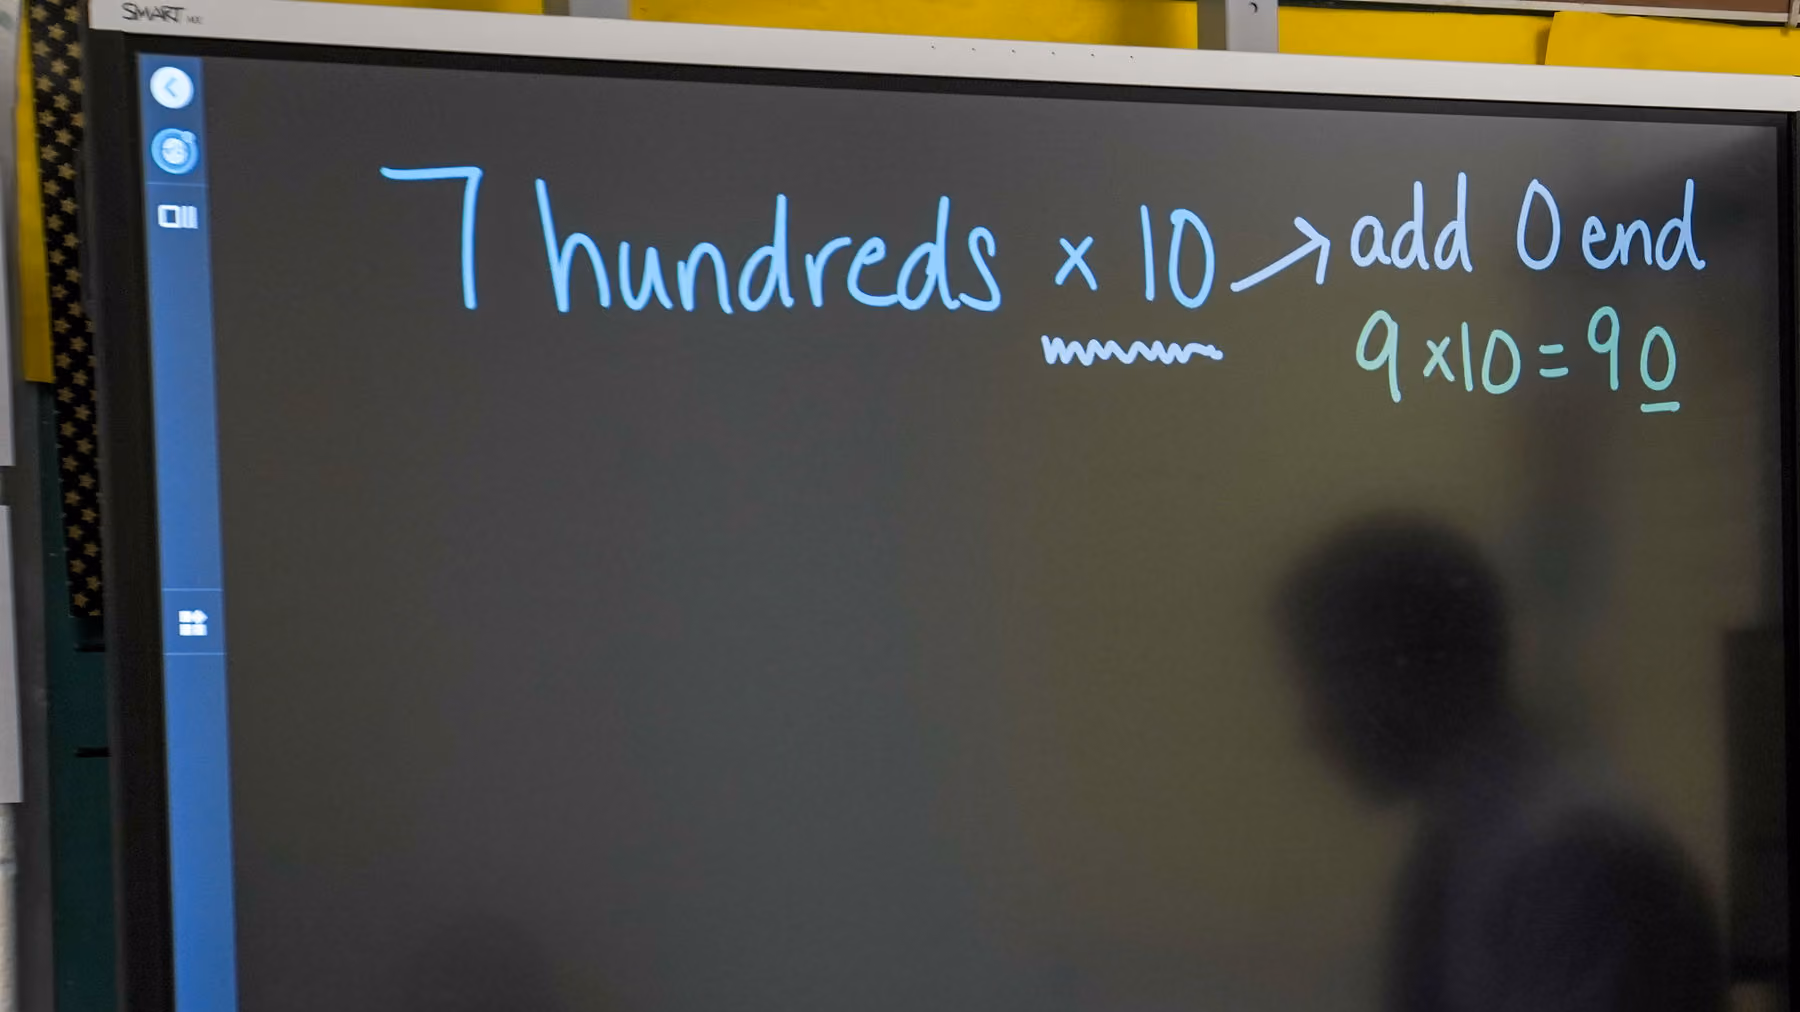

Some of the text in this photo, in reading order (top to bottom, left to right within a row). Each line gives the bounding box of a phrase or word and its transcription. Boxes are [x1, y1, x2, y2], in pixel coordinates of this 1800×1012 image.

[121, 2, 185, 23] SMART
[380, 166, 482, 309] 7
[535, 178, 1001, 313] hundreds
[1140, 204, 1215, 308] 10
[1350, 172, 1473, 272] add
[1582, 179, 1705, 271] end
